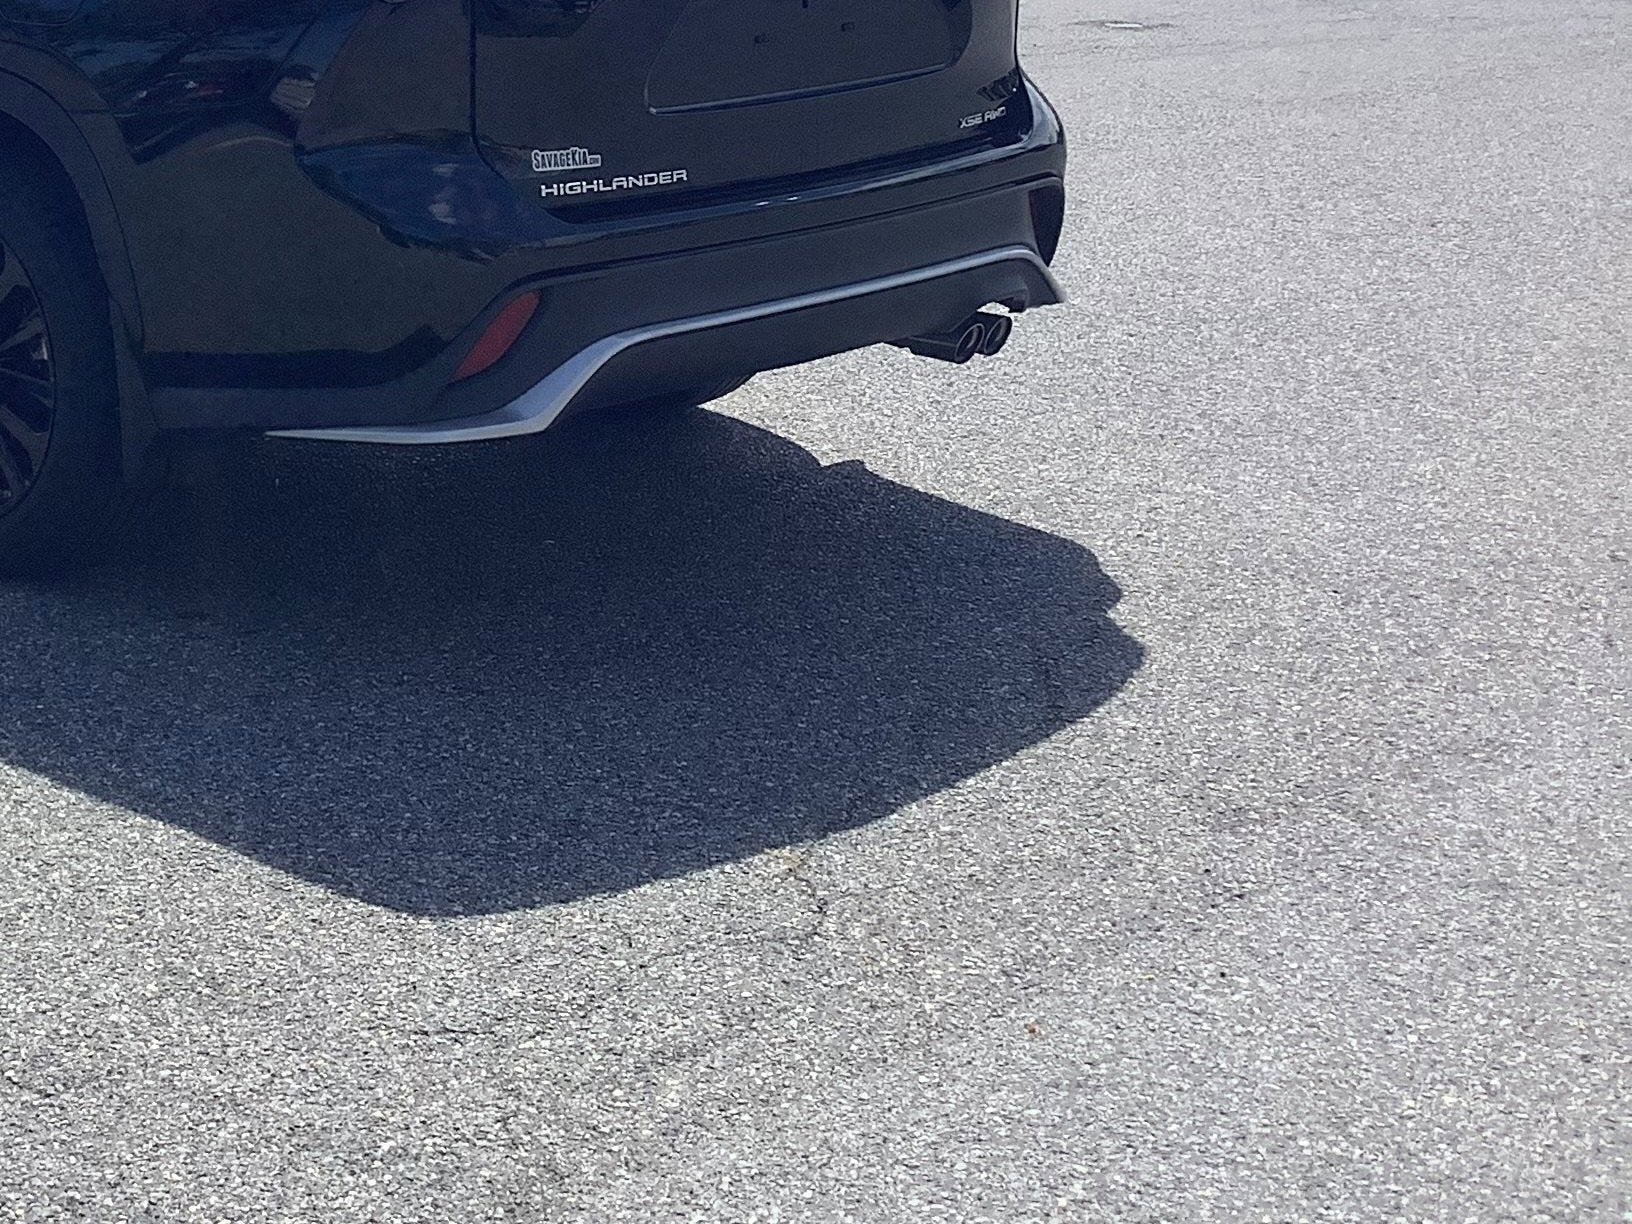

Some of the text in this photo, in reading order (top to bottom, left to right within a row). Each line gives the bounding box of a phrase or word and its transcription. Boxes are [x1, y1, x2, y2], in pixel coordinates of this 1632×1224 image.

[959, 106, 1007, 129] XSE AWD
[540, 169, 688, 197] HIGHLANDER
